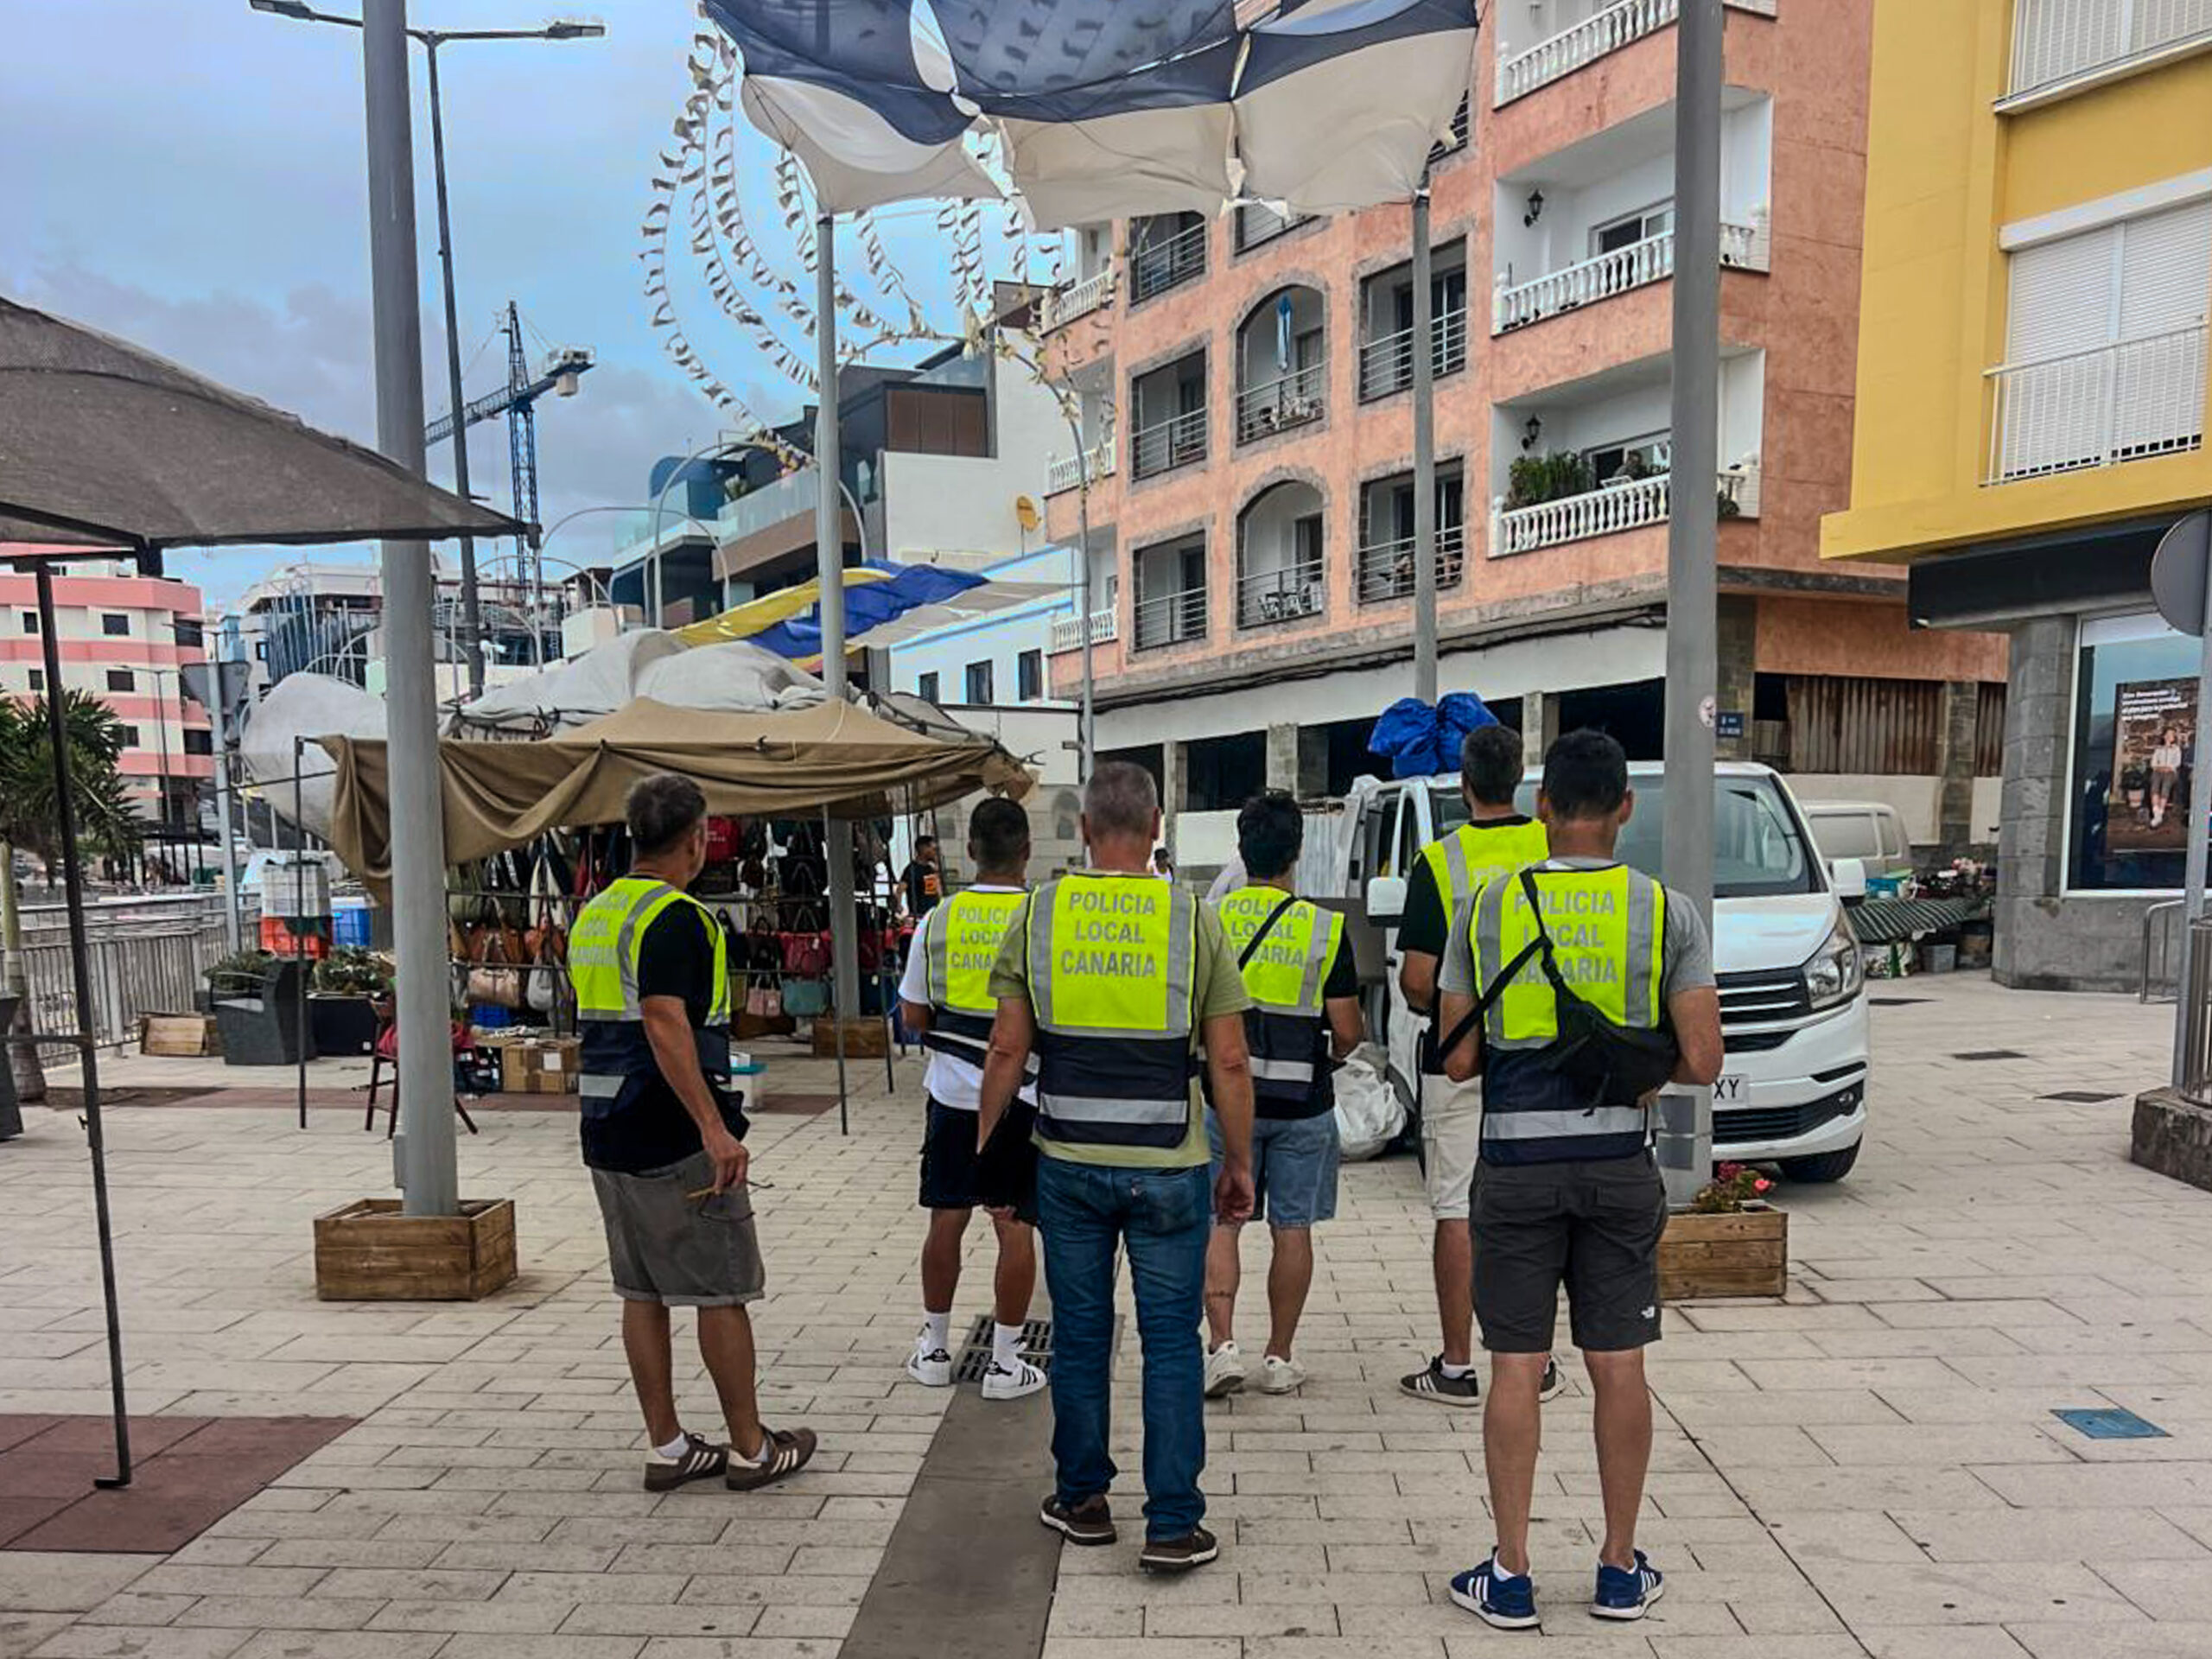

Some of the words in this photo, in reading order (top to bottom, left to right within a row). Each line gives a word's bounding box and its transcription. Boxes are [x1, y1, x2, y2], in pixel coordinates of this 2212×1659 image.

[1069, 891, 1156, 915] POLICIA
[1224, 897, 1308, 920] POLIIA
[957, 906, 1011, 925] POLICI
[960, 930, 1002, 947] LOCA
[1075, 919, 1146, 944] LOCAL
[1230, 921, 1296, 940] LOAL
[951, 951, 994, 969] CANA
[1061, 949, 1156, 978] CANARIA
[1512, 956, 1618, 983] AARIA
[1713, 1077, 1740, 1101] XY
